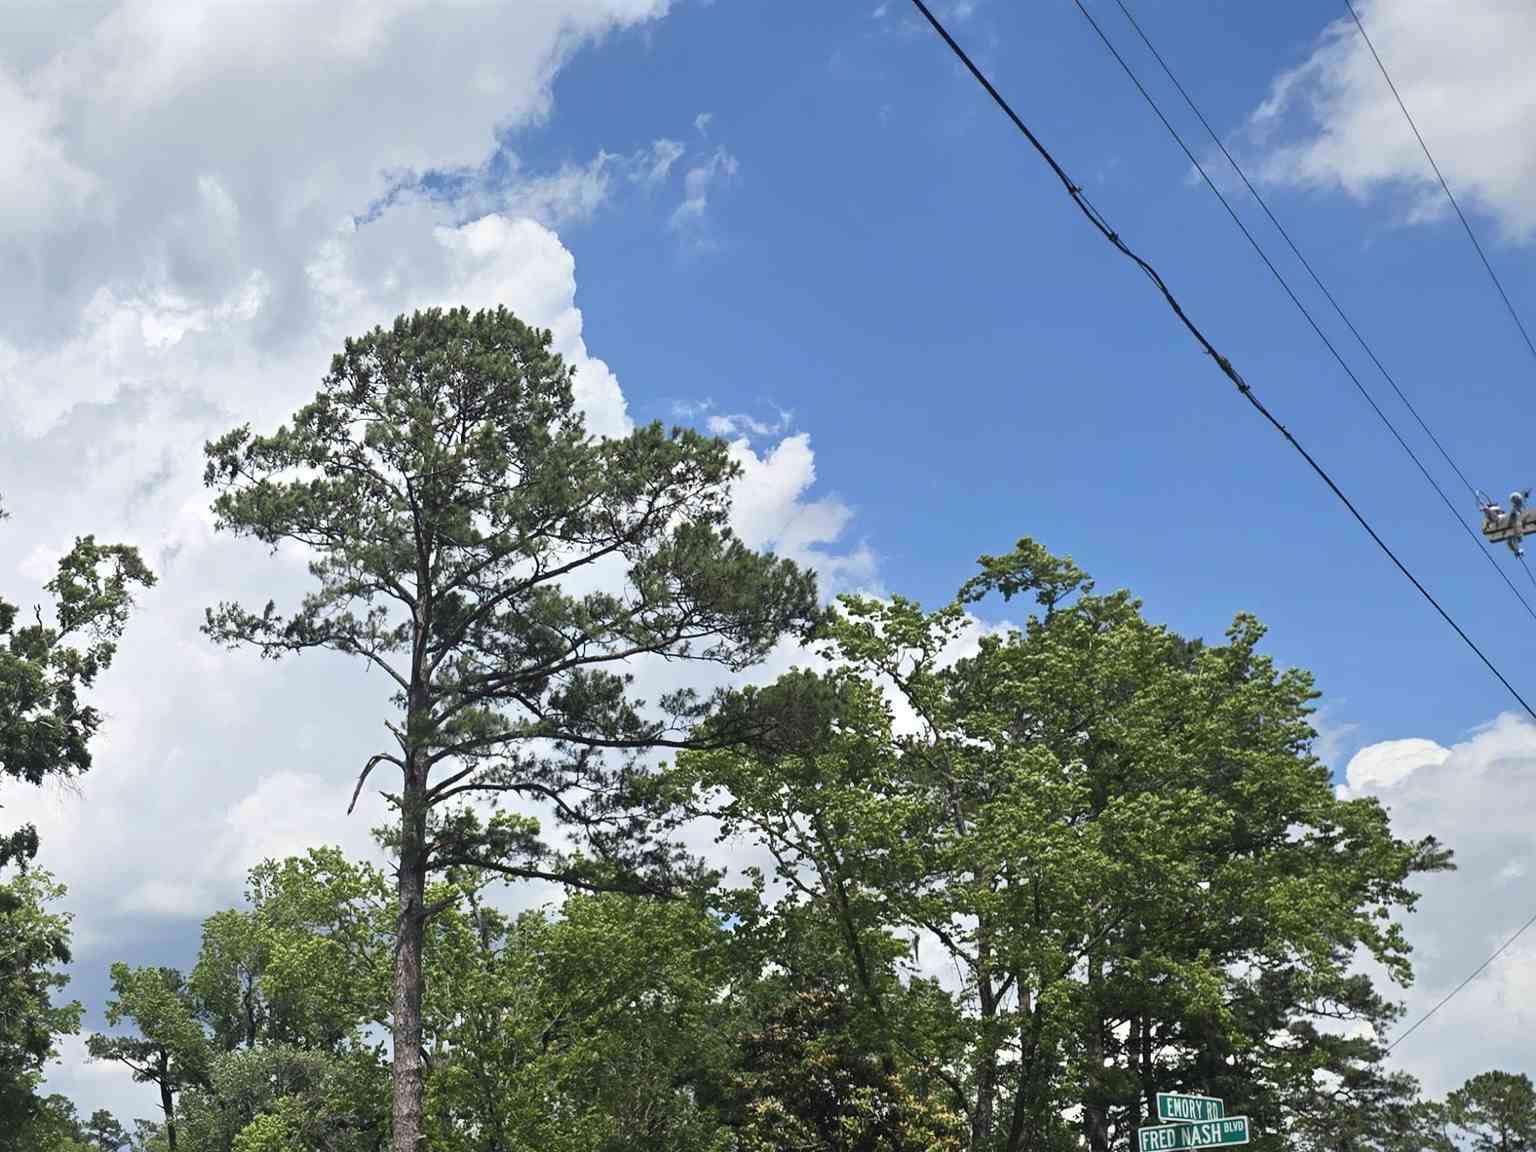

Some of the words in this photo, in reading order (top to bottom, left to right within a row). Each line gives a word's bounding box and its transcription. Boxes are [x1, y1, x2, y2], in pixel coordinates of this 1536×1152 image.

[1166, 1098, 1202, 1119] EMORY
[1206, 1101, 1219, 1121] RD
[1143, 1128, 1176, 1151] FRED
[1181, 1122, 1222, 1146] NASH
[1223, 1120, 1244, 1133] BLVD
